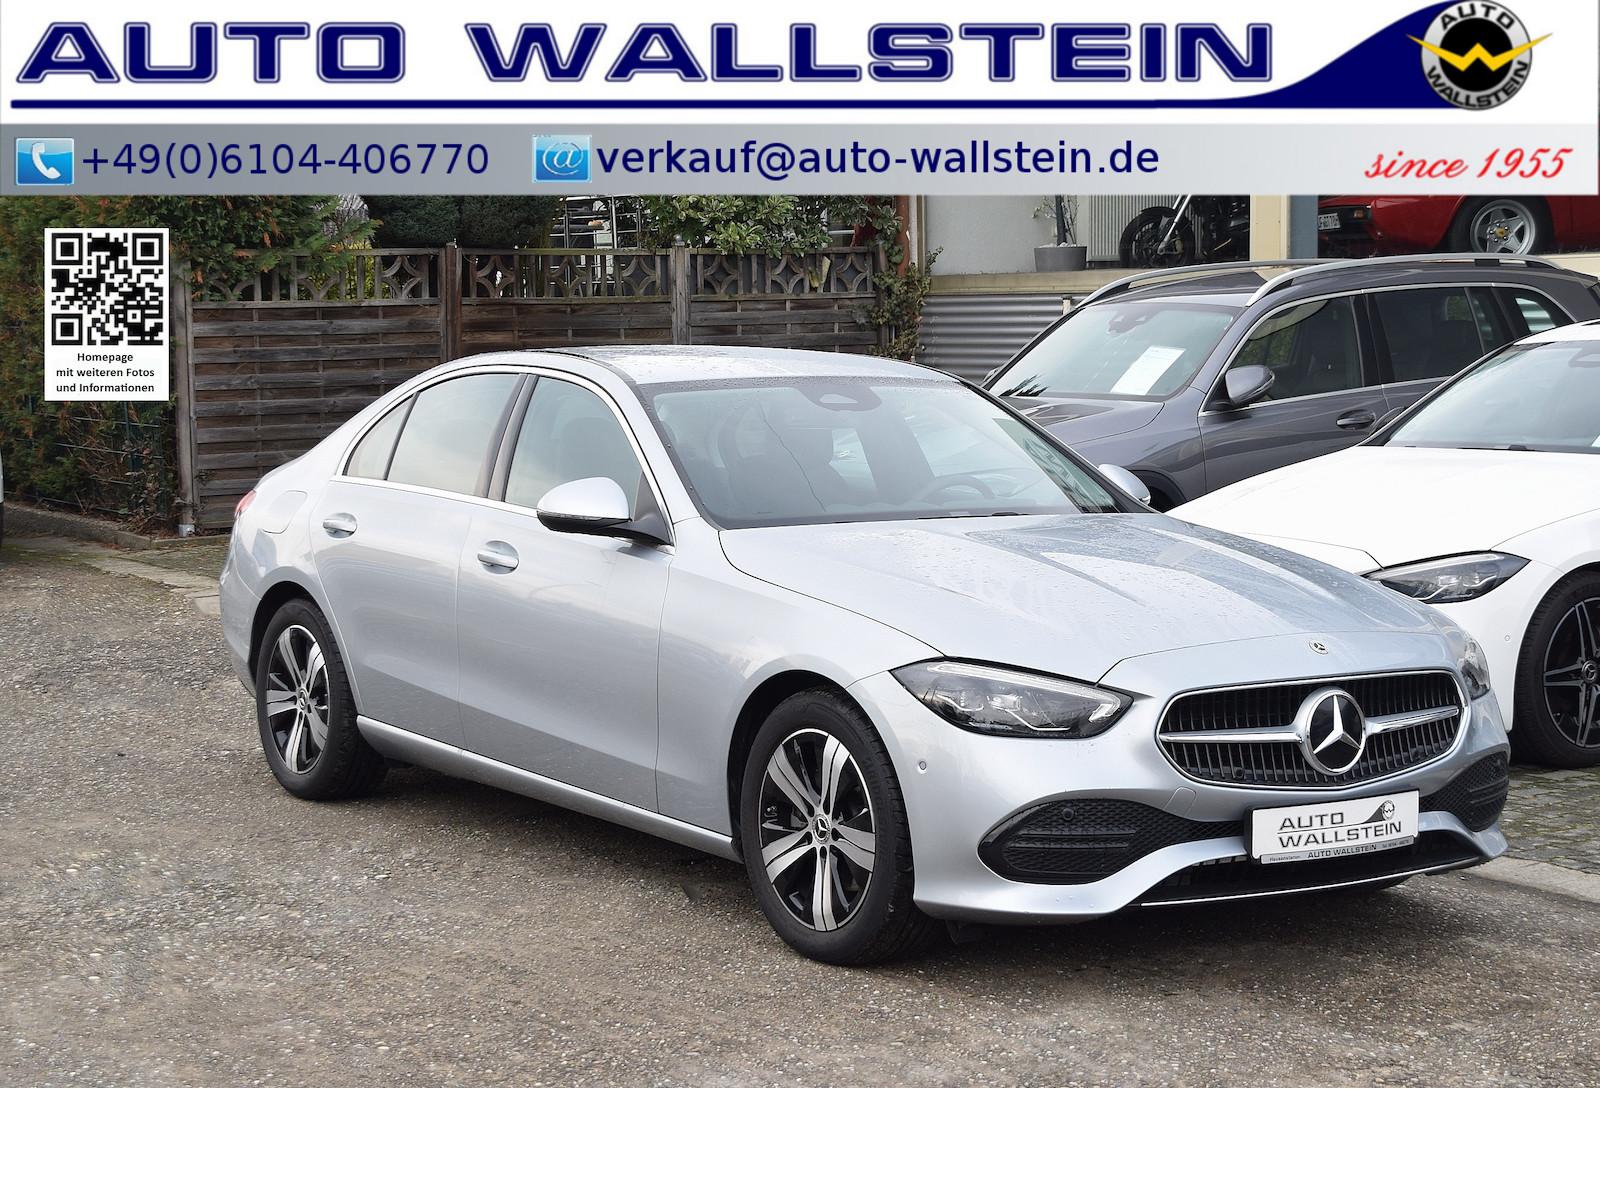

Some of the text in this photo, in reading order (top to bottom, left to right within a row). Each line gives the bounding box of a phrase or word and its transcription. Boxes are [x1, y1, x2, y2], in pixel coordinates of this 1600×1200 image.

[1279, 812, 1344, 831] AUTO
[1279, 821, 1402, 848] WALLSTEIN
[1307, 850, 1331, 859] AUTO
[1333, 844, 1377, 856] WALLSTEIN
